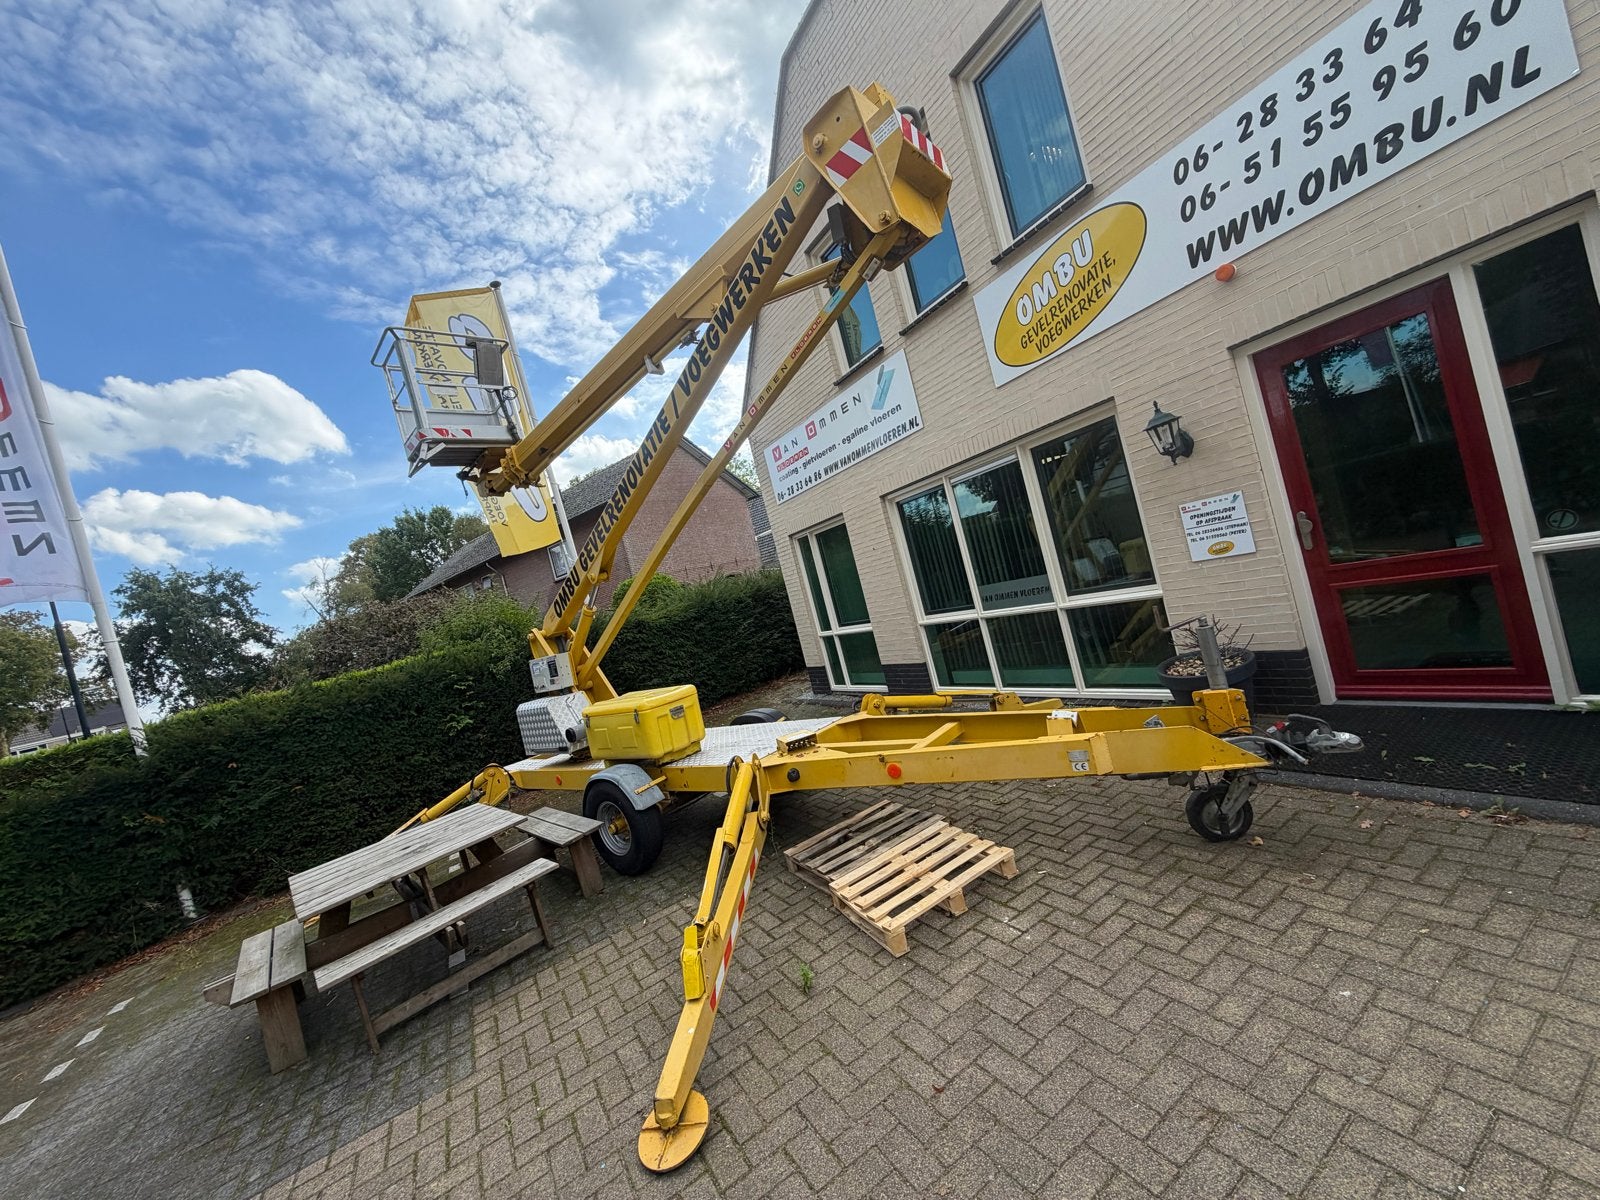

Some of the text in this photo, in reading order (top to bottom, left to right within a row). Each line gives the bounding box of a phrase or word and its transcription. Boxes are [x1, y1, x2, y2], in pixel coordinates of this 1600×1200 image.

[1173, 0, 1423, 185] 06- 28 33 64
[1180, 0, 1522, 222] 06- 51 55 95 60
[1186, 45, 1541, 269] WWW.OMBU.NL
[1016, 228, 1094, 326] OMBU
[1020, 251, 1116, 349] GEVELRENOVATIE,
[1035, 274, 1112, 354] VOEGWERKEN
[553, 565, 580, 619] OMBU
[578, 408, 671, 572] GEVELRENOVATIE
[677, 196, 797, 398] VOEGWERKEN
[724, 422, 746, 452] VAN
[778, 466, 799, 482] coating
[802, 443, 837, 470] gietvloeren
[841, 424, 869, 445] egaline
[869, 404, 902, 428] vloeren
[772, 437, 798, 462] VAN
[795, 480, 804, 492] 33
[804, 475, 813, 487] 64
[813, 470, 822, 482] 86
[823, 416, 920, 476] WWW.VANOMMENVLOEREN.NL
[1190, 506, 1236, 520] OPENINGSTIJDEN
[1205, 514, 1233, 524] AFSPRAAK
